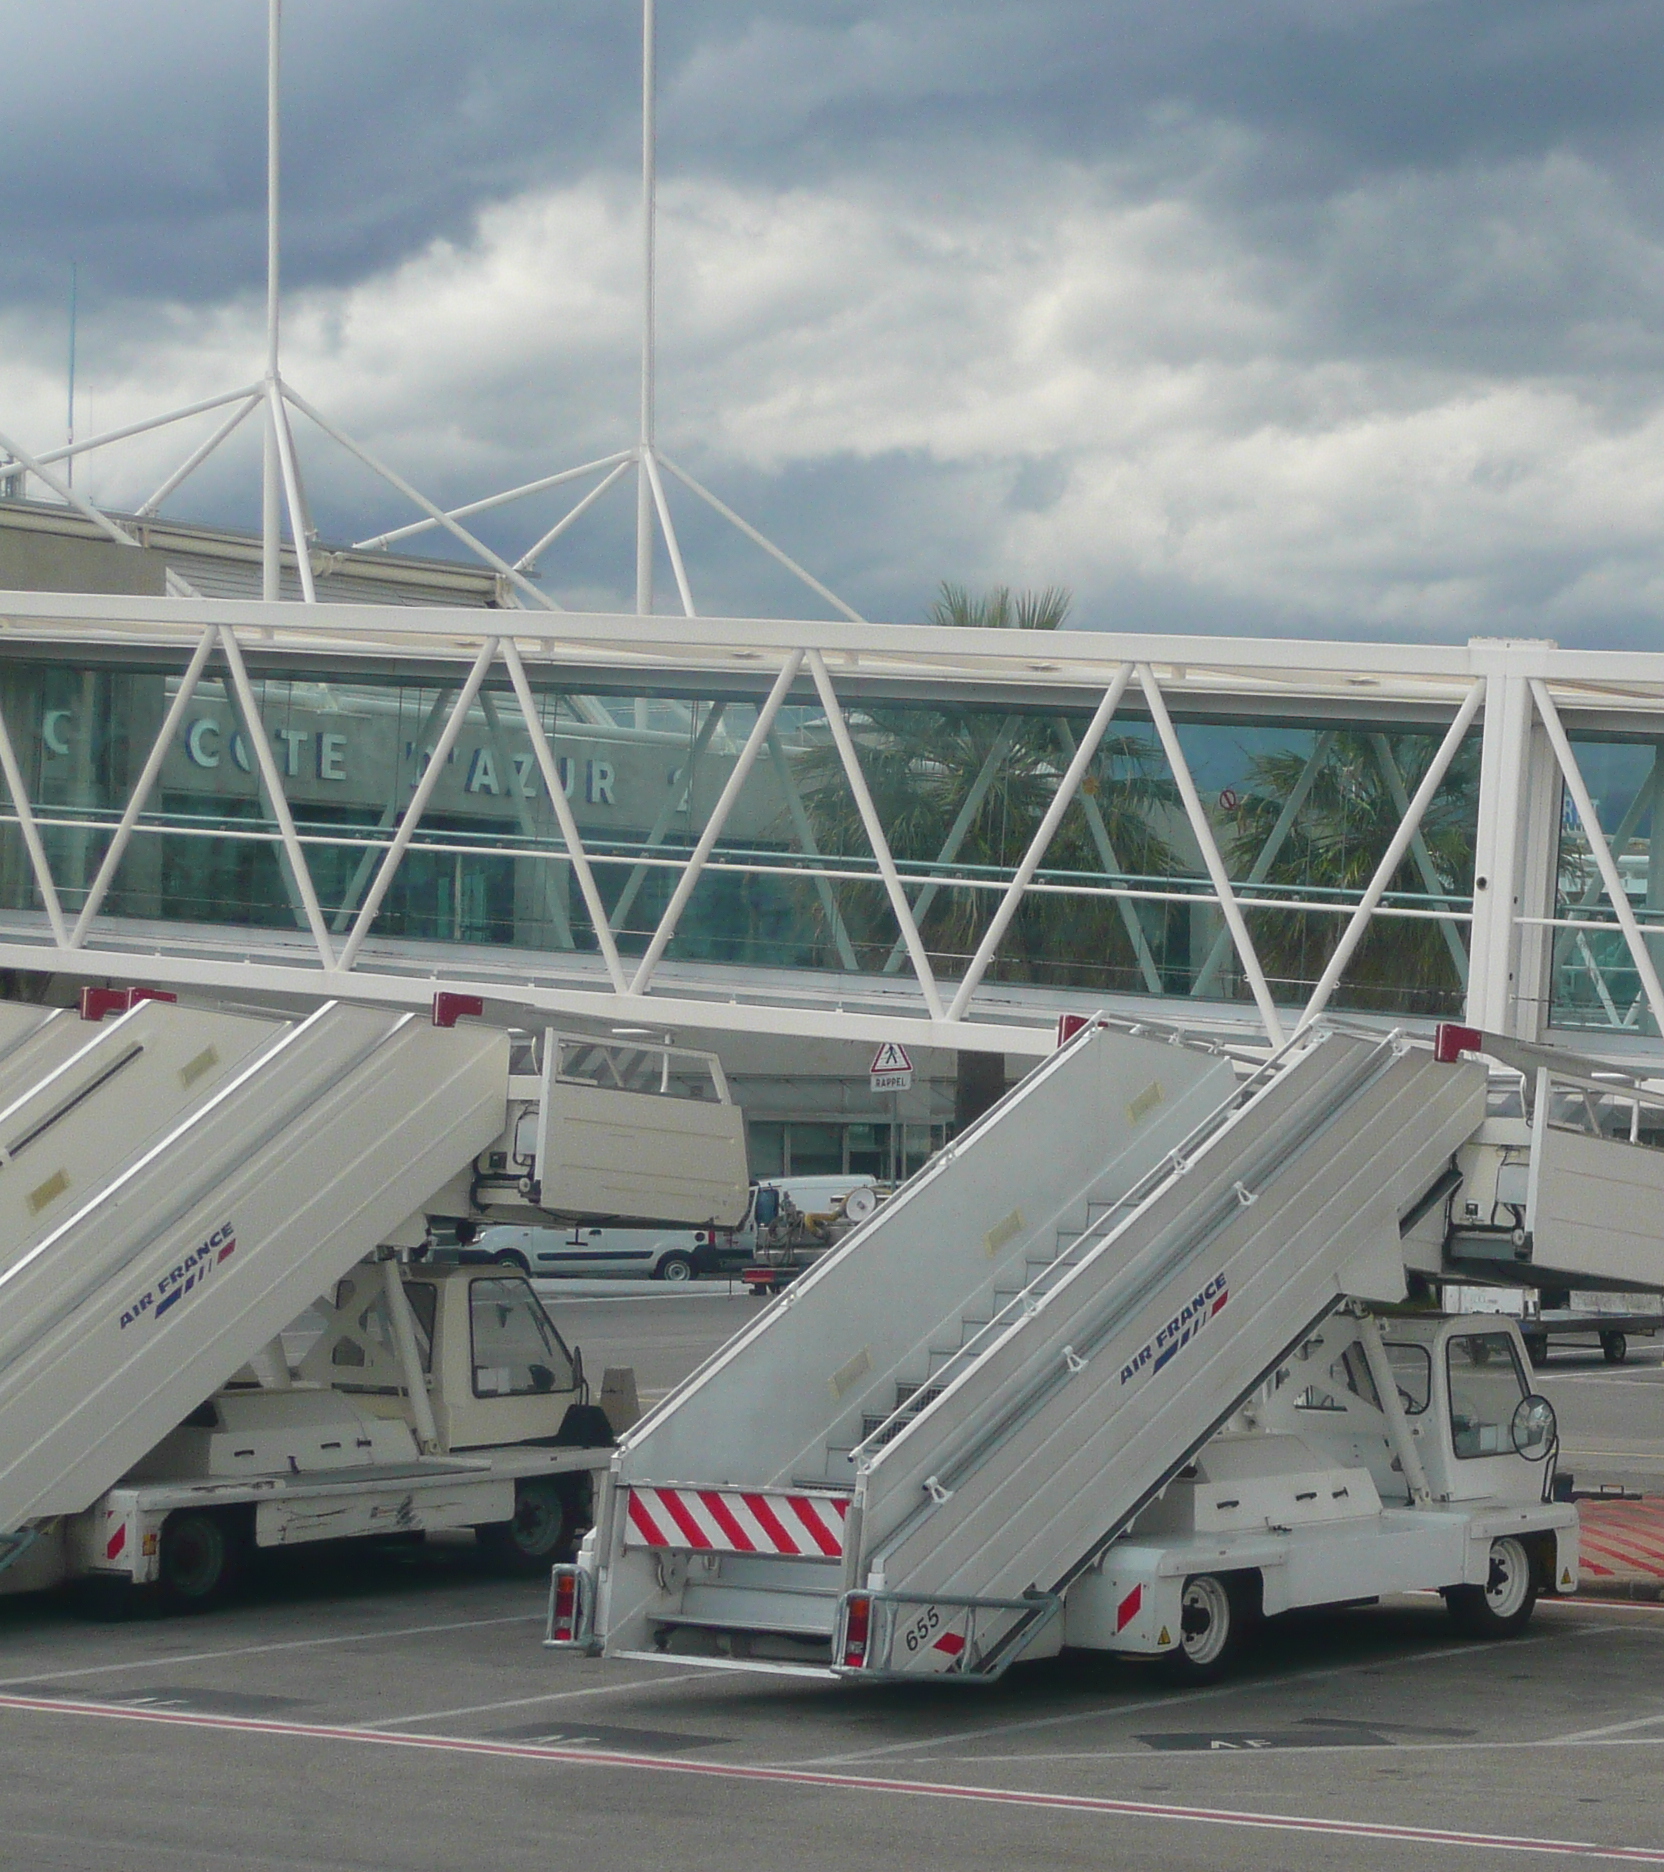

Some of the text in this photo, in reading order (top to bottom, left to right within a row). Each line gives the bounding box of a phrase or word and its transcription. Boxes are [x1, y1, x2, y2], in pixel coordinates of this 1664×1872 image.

[875, 1076, 906, 1088] RAPPEL
[119, 1221, 234, 1330] AIR FRANCE
[1120, 1271, 1228, 1386] AIR FRANCE
[905, 1605, 940, 1652] 655
